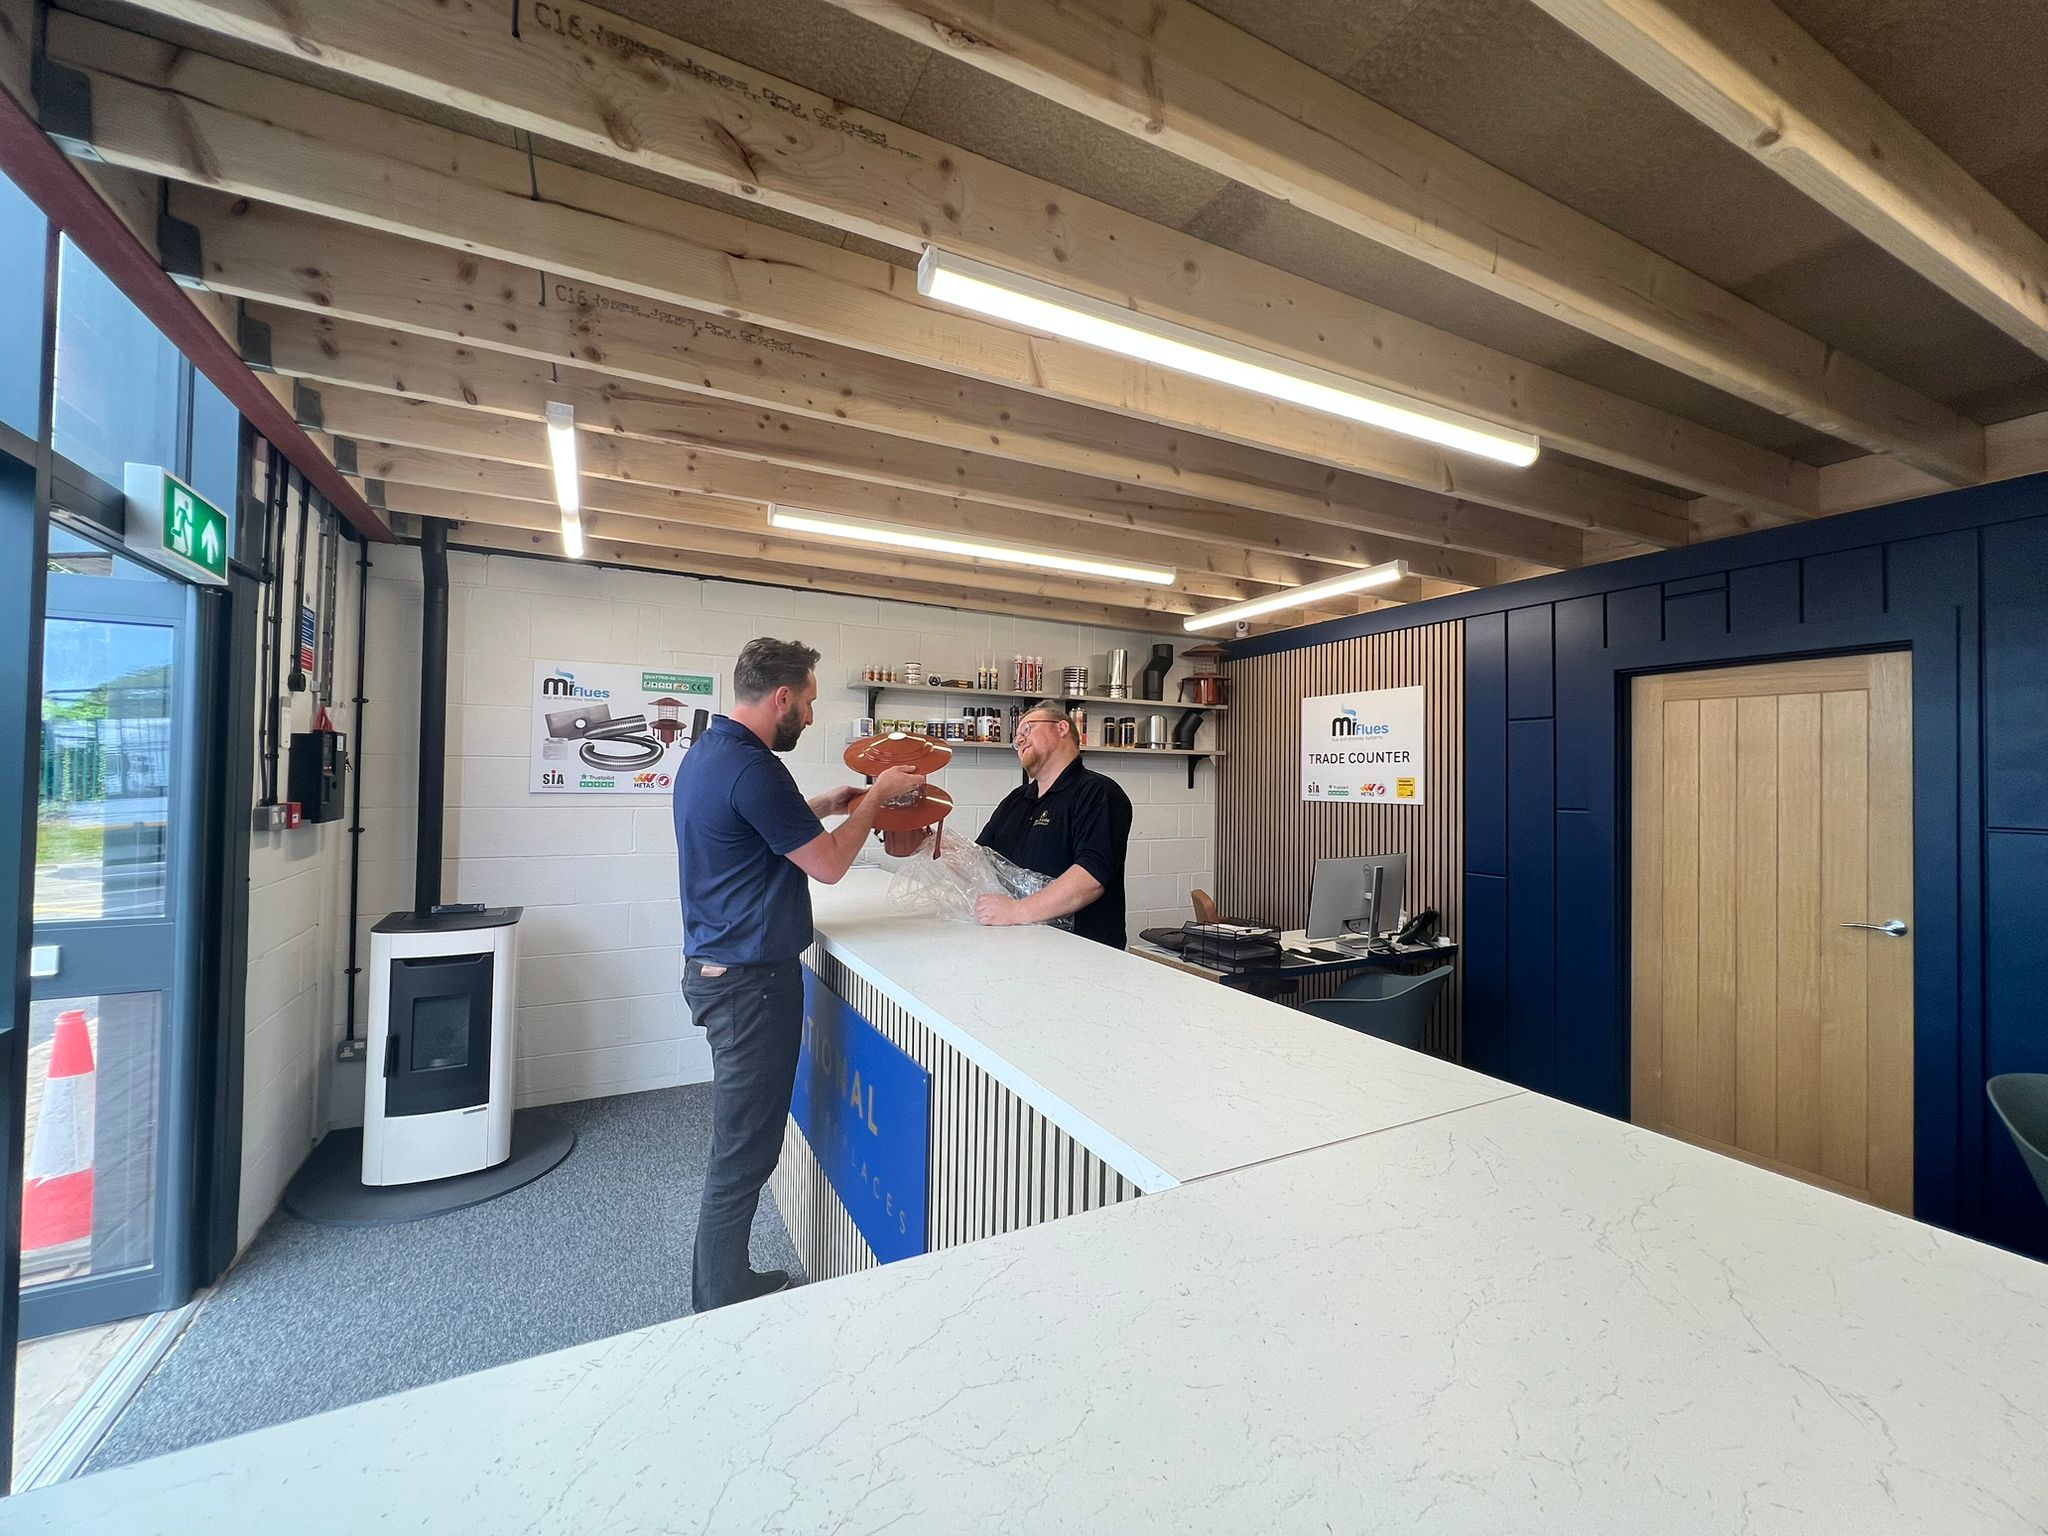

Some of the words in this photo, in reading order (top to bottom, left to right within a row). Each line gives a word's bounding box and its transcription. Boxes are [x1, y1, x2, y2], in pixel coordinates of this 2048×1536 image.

[679, 57, 749, 91] Jones
[762, 87, 802, 111] Dry
[812, 106, 888, 144] Graded
[555, 284, 588, 307] C16
[1308, 753, 1346, 765] TRADE
[1347, 750, 1411, 764] COUNTER
